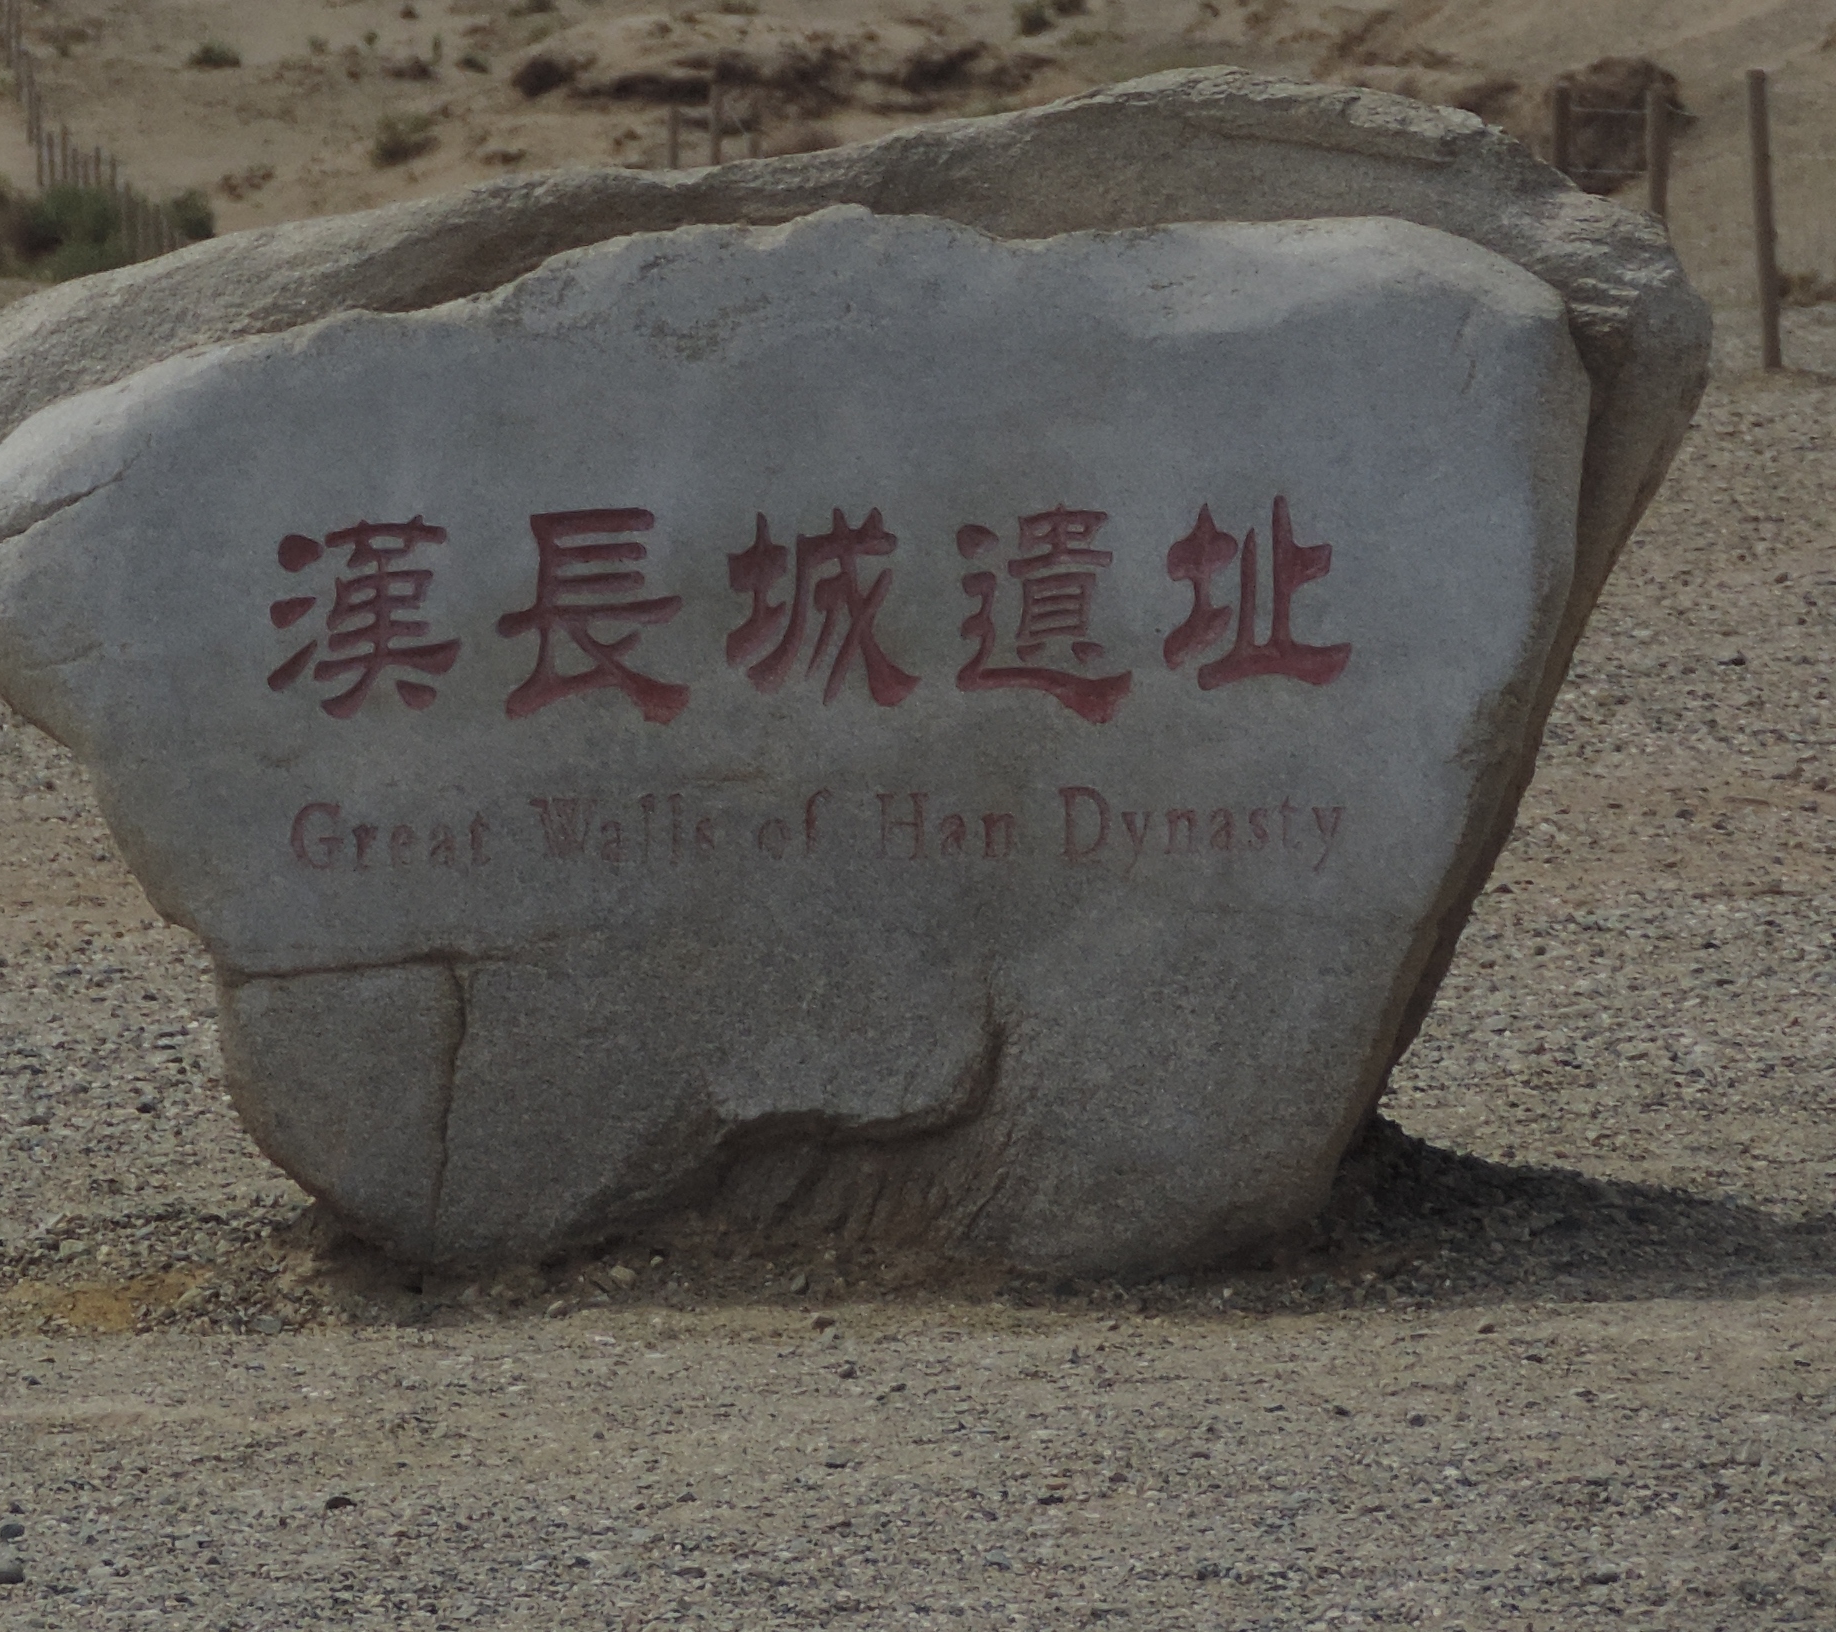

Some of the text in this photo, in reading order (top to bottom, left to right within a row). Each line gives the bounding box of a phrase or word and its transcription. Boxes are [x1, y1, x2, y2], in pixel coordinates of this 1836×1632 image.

[267, 494, 1352, 724] 漢長城遺址
[290, 785, 1346, 881] Great Walls of Han Dynasty
